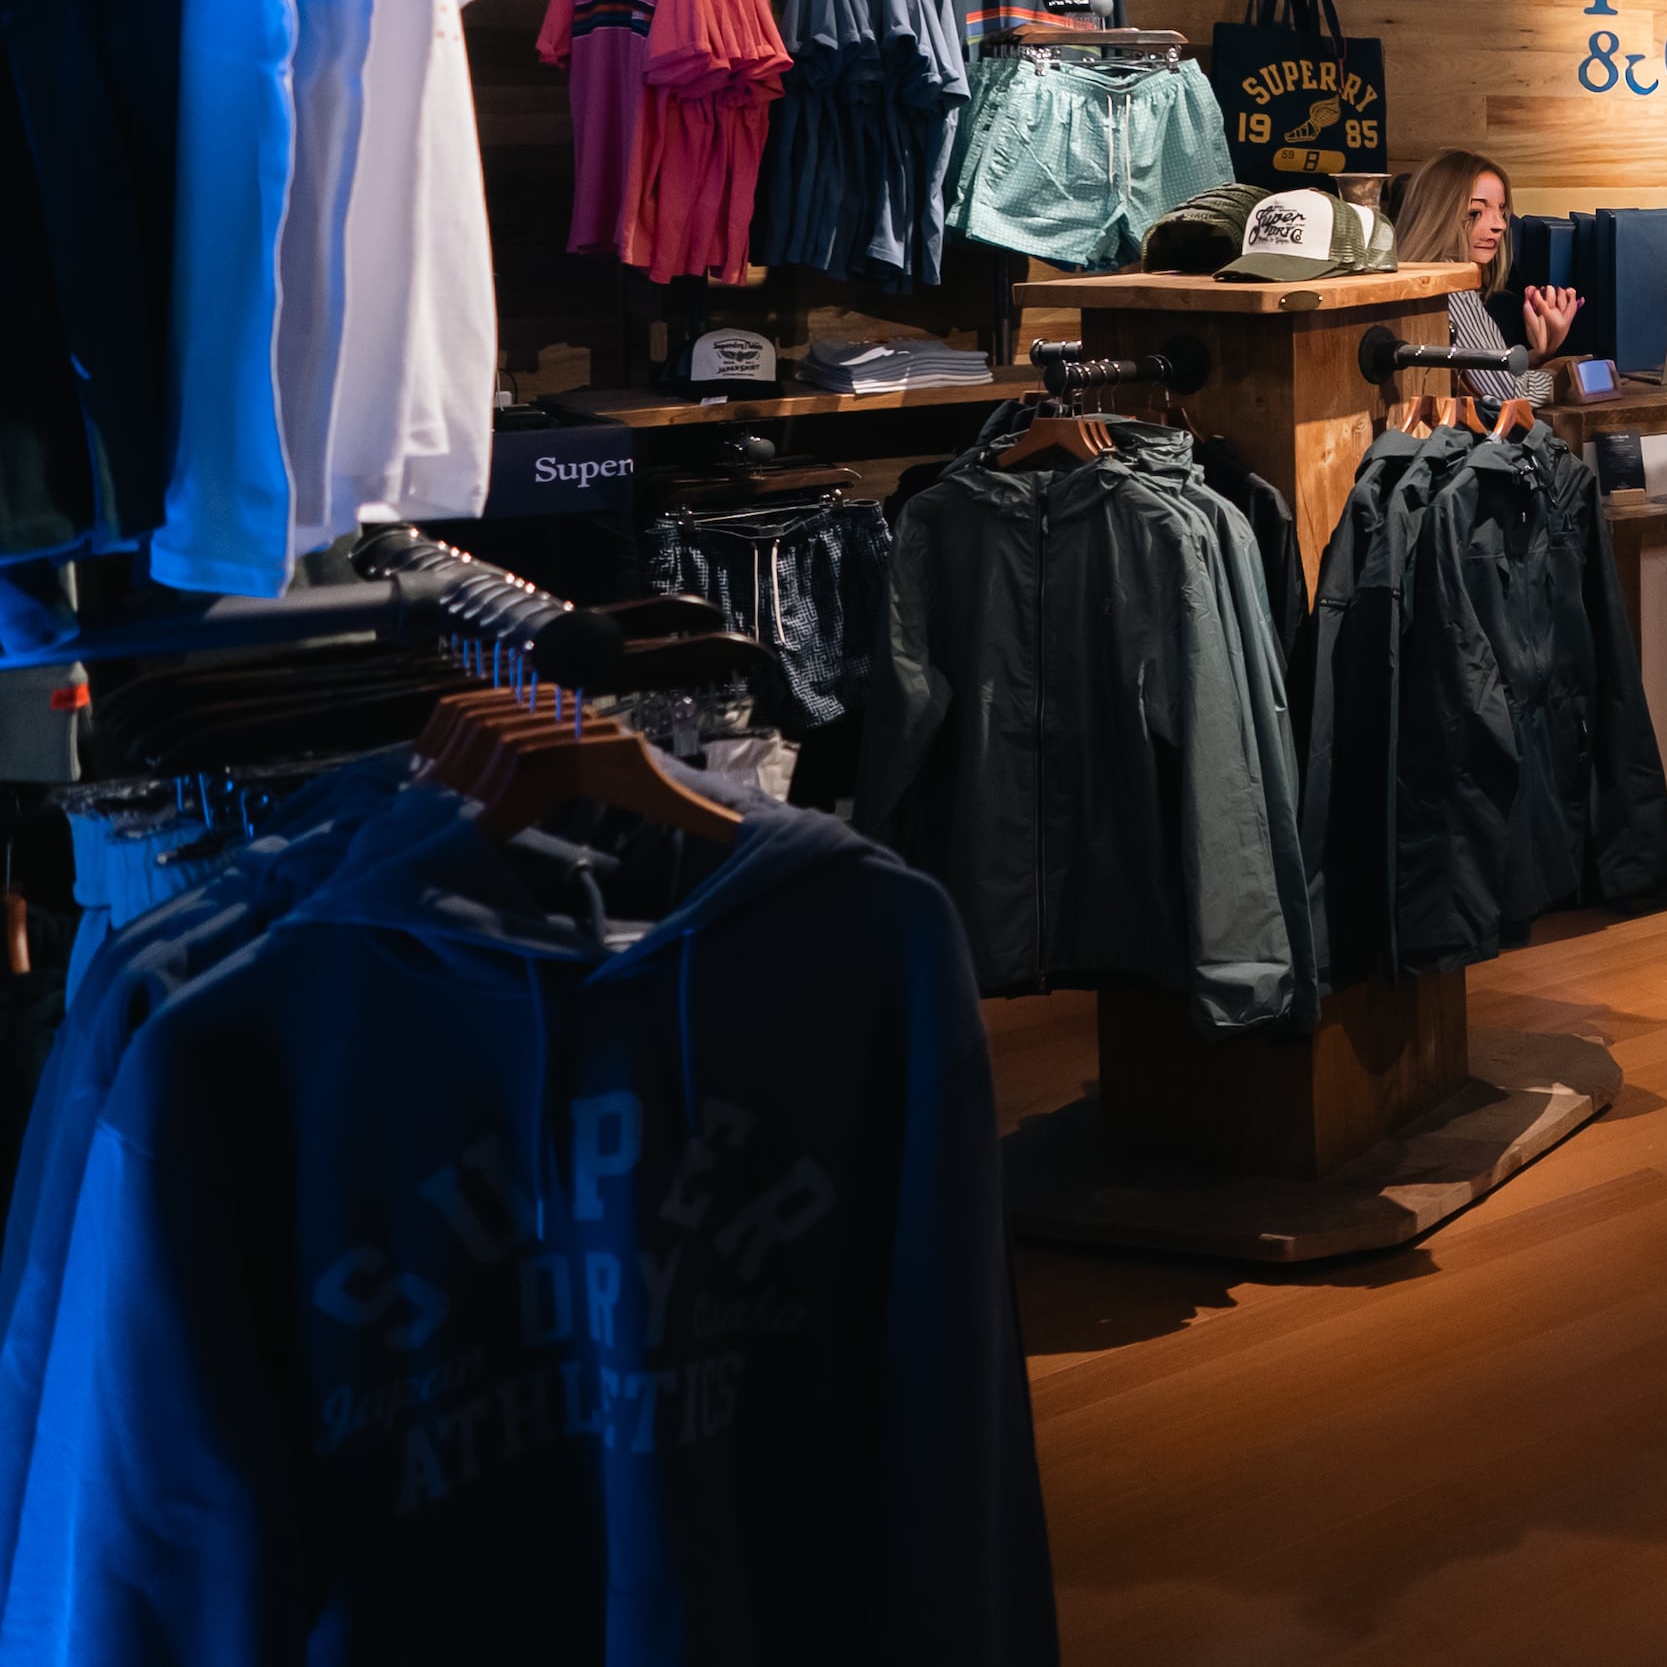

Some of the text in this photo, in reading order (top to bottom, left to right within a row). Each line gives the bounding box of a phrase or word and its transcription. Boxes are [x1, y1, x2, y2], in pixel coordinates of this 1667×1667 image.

[1242, 60, 1378, 112] SUPERRY
[1238, 112, 1378, 148] 19 85
[309, 1090, 837, 1351] SUPER
[520, 1246, 682, 1349] DRY
